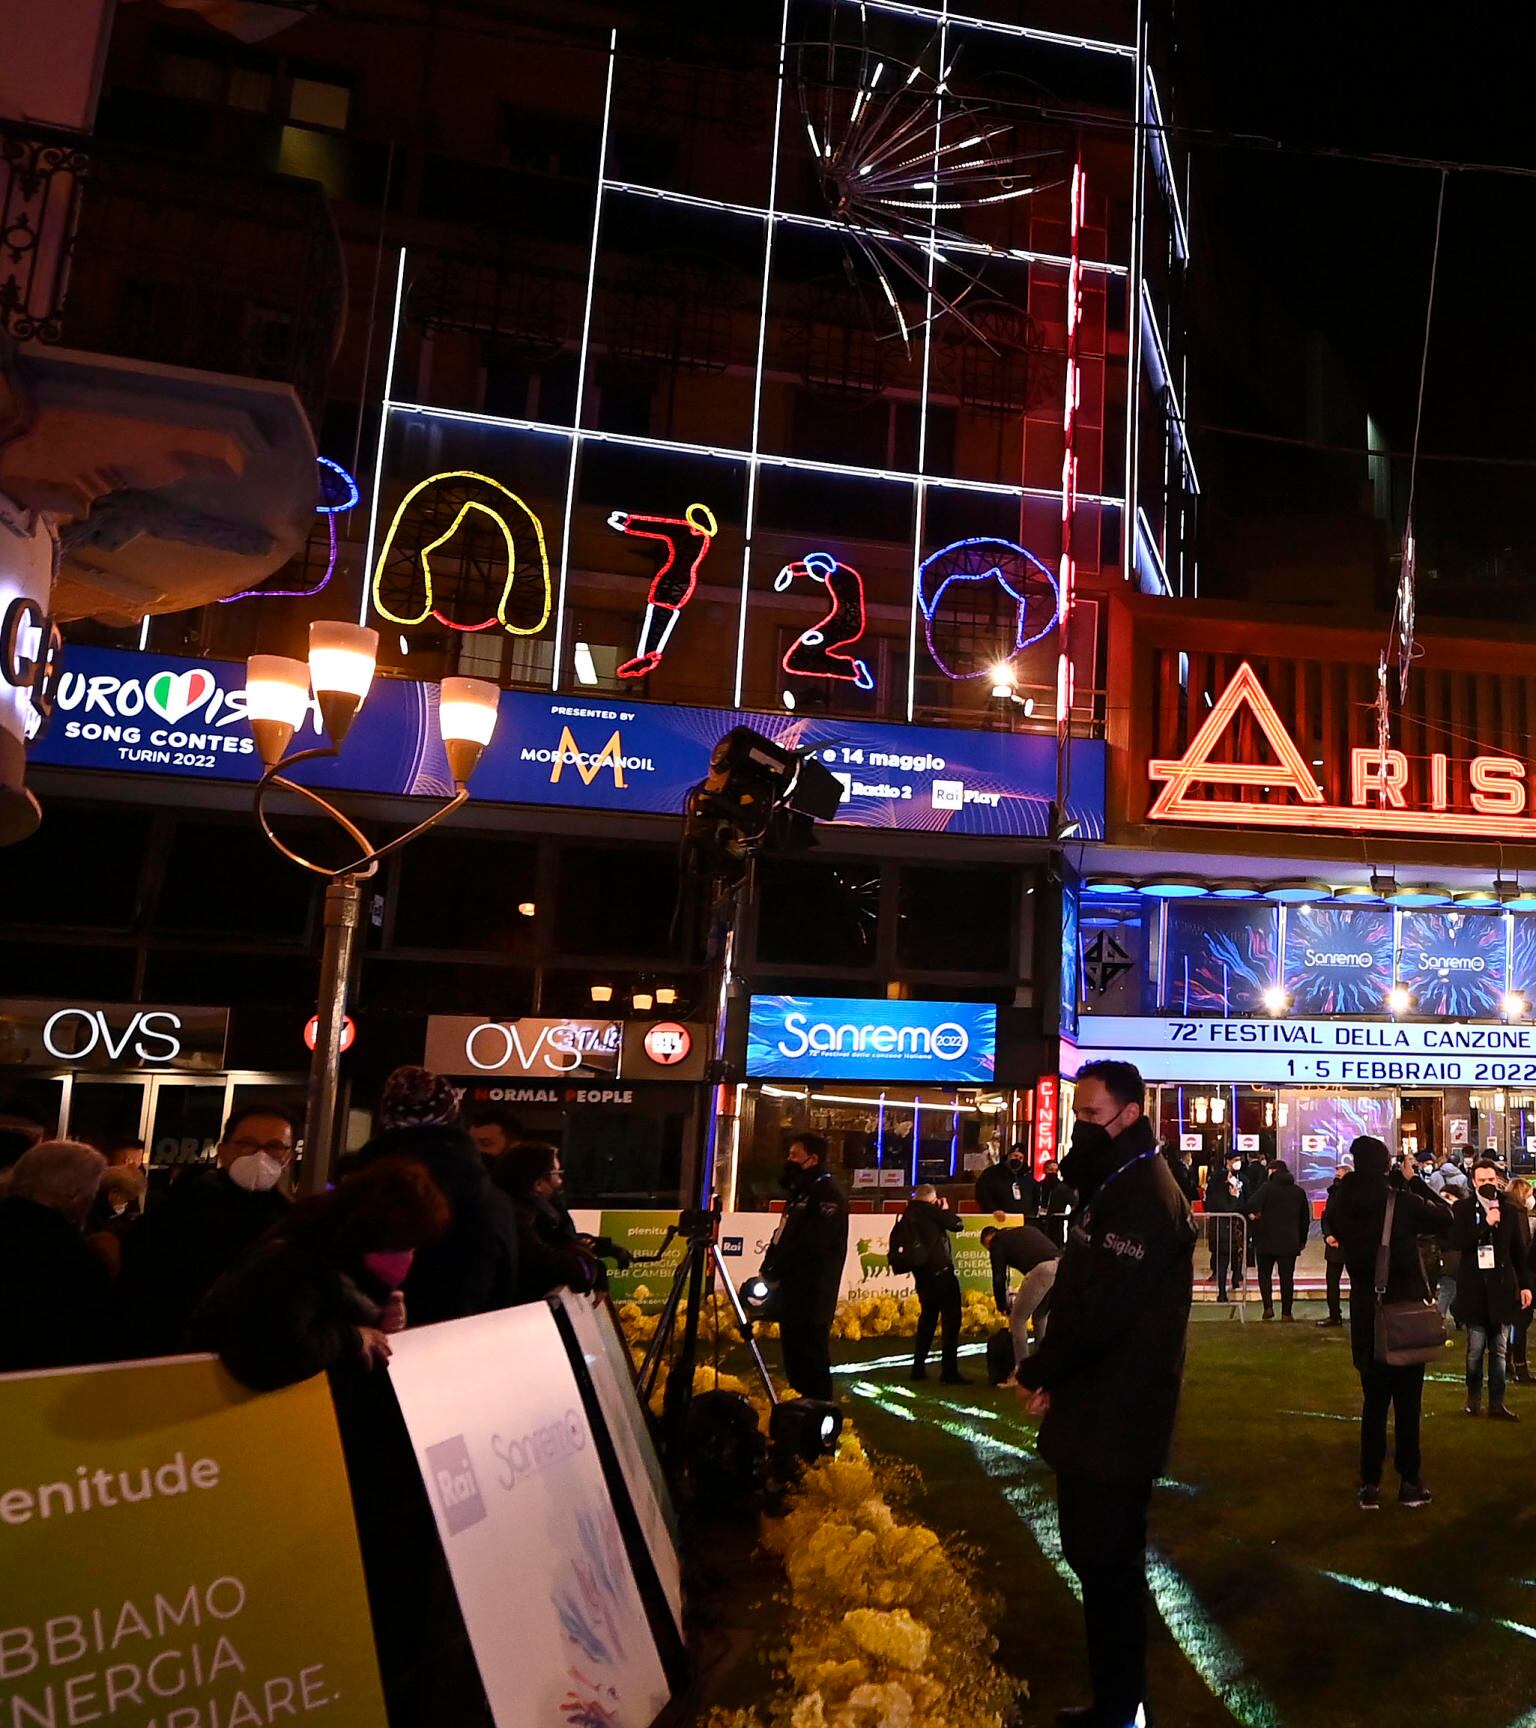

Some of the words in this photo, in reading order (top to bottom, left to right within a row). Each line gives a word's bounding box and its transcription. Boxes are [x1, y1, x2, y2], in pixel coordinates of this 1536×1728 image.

[551, 706, 617, 720] PRESENTED
[619, 713, 635, 721] BY
[65, 721, 141, 743] SONG
[150, 730, 254, 754] CONTES
[118, 747, 170, 762] TURIN
[173, 751, 215, 767] 2022
[520, 748, 655, 771] MOROCCANOIL
[823, 749, 836, 761] e
[841, 747, 864, 764] 14
[869, 751, 945, 771] maggio
[851, 781, 900, 799] Radio
[901, 786, 912, 799] 2
[1304, 949, 1372, 967] Sanremo
[1418, 952, 1484, 971] Sanremo
[43, 1008, 181, 1061] OVS
[778, 1012, 969, 1061] Sanremo
[936, 1035, 962, 1047] 2022
[1210, 1024, 1322, 1044] FESTIVAL
[1336, 1028, 1409, 1047] DELLA
[1424, 1030, 1530, 1048] CANZONE
[466, 1023, 582, 1071] OVS
[1342, 1062, 1460, 1079] FEBBRAIO
[1475, 1064, 1536, 1081] 2022
[1038, 1082, 1053, 1163] CINEMA
[627, 1227, 668, 1236] plenitu
[956, 1229, 981, 1238] plenit
[955, 1250, 991, 1259] ABBIA
[958, 1260, 991, 1268] ENERG
[437, 1462, 475, 1508] Rai
